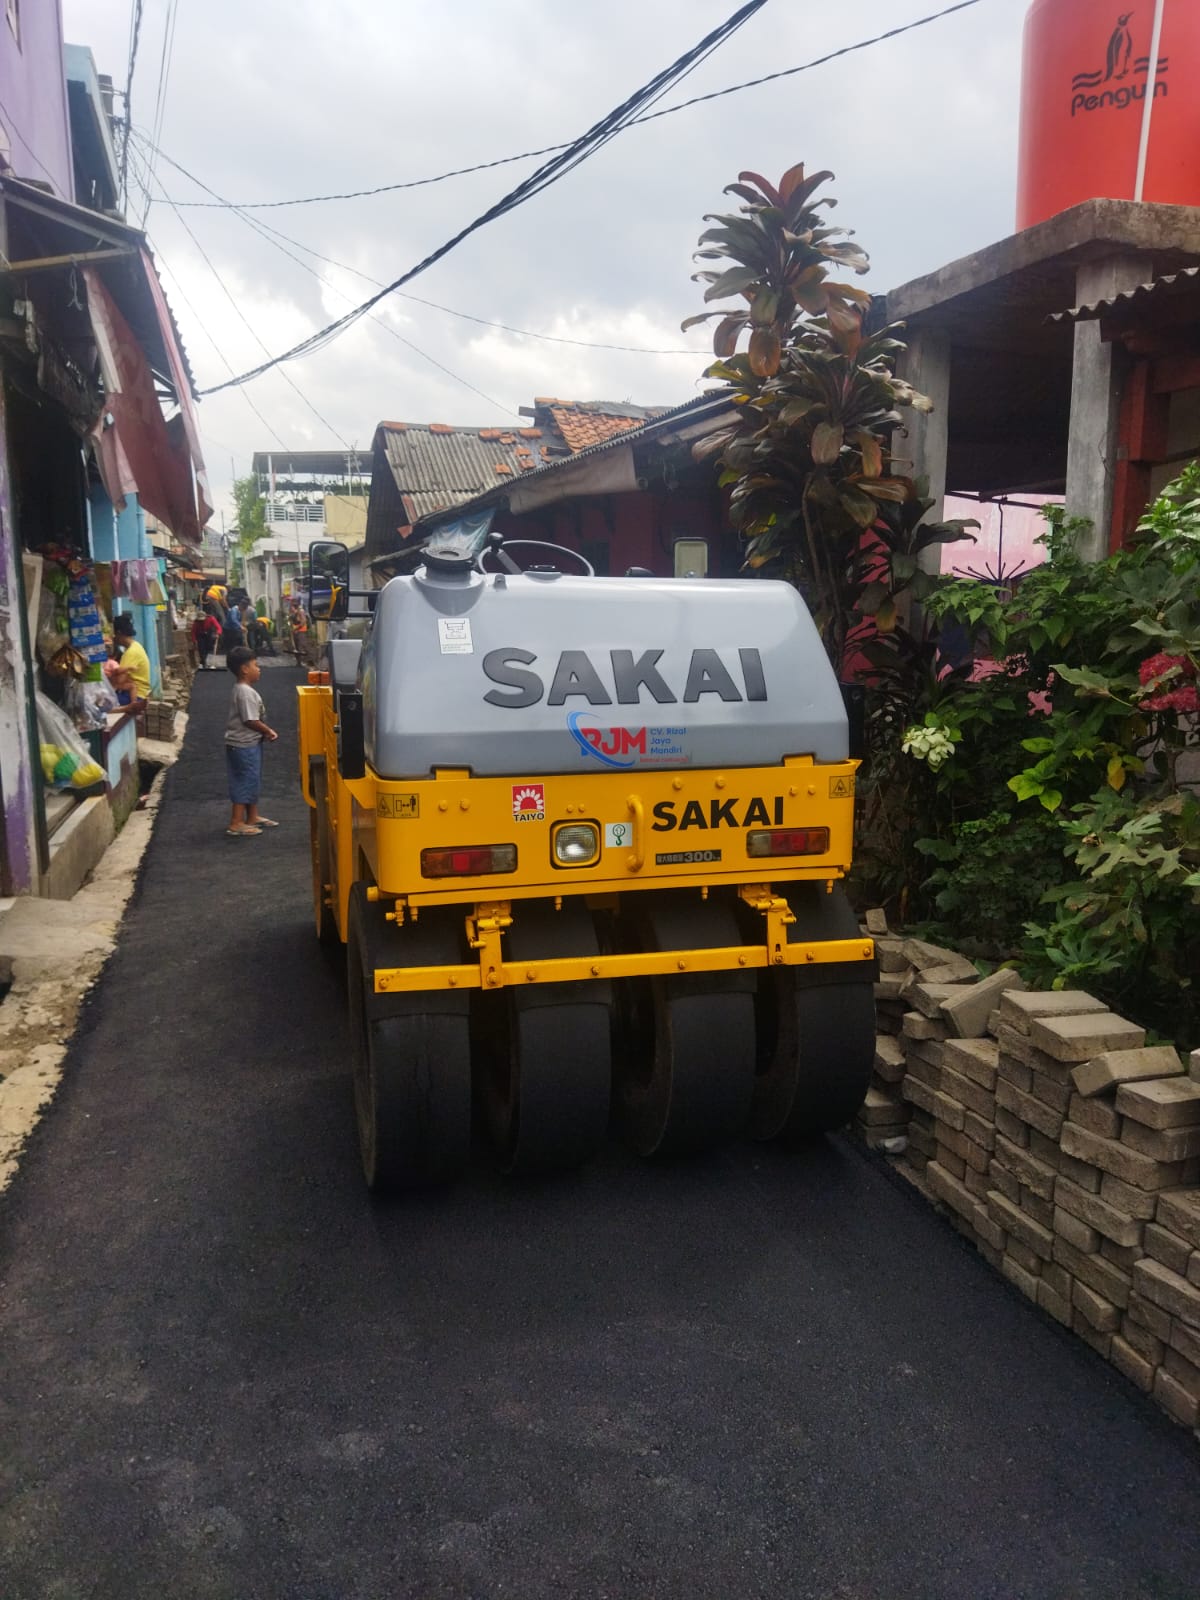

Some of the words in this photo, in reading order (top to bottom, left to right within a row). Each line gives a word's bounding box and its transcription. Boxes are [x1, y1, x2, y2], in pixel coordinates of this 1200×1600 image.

[482, 647, 768, 709] SAKAI
[650, 737, 672, 745] Jaya
[650, 745, 682, 754] Mandiri
[513, 812, 545, 822] TAIYO
[651, 796, 784, 832] SAKAI
[684, 851, 713, 863] 300
